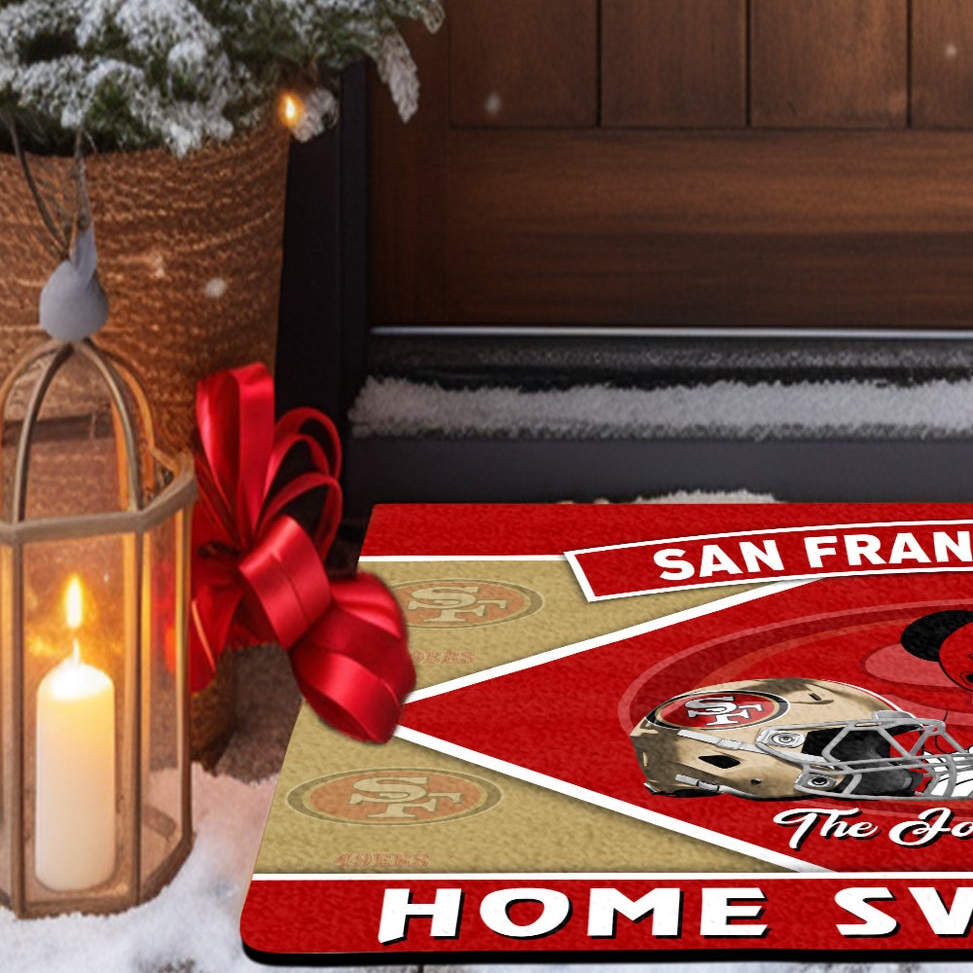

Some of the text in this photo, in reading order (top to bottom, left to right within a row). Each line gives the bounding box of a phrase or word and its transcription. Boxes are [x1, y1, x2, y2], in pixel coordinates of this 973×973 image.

[653, 539, 785, 581] SAN
[772, 807, 879, 850] The
[377, 887, 769, 944] HOME
